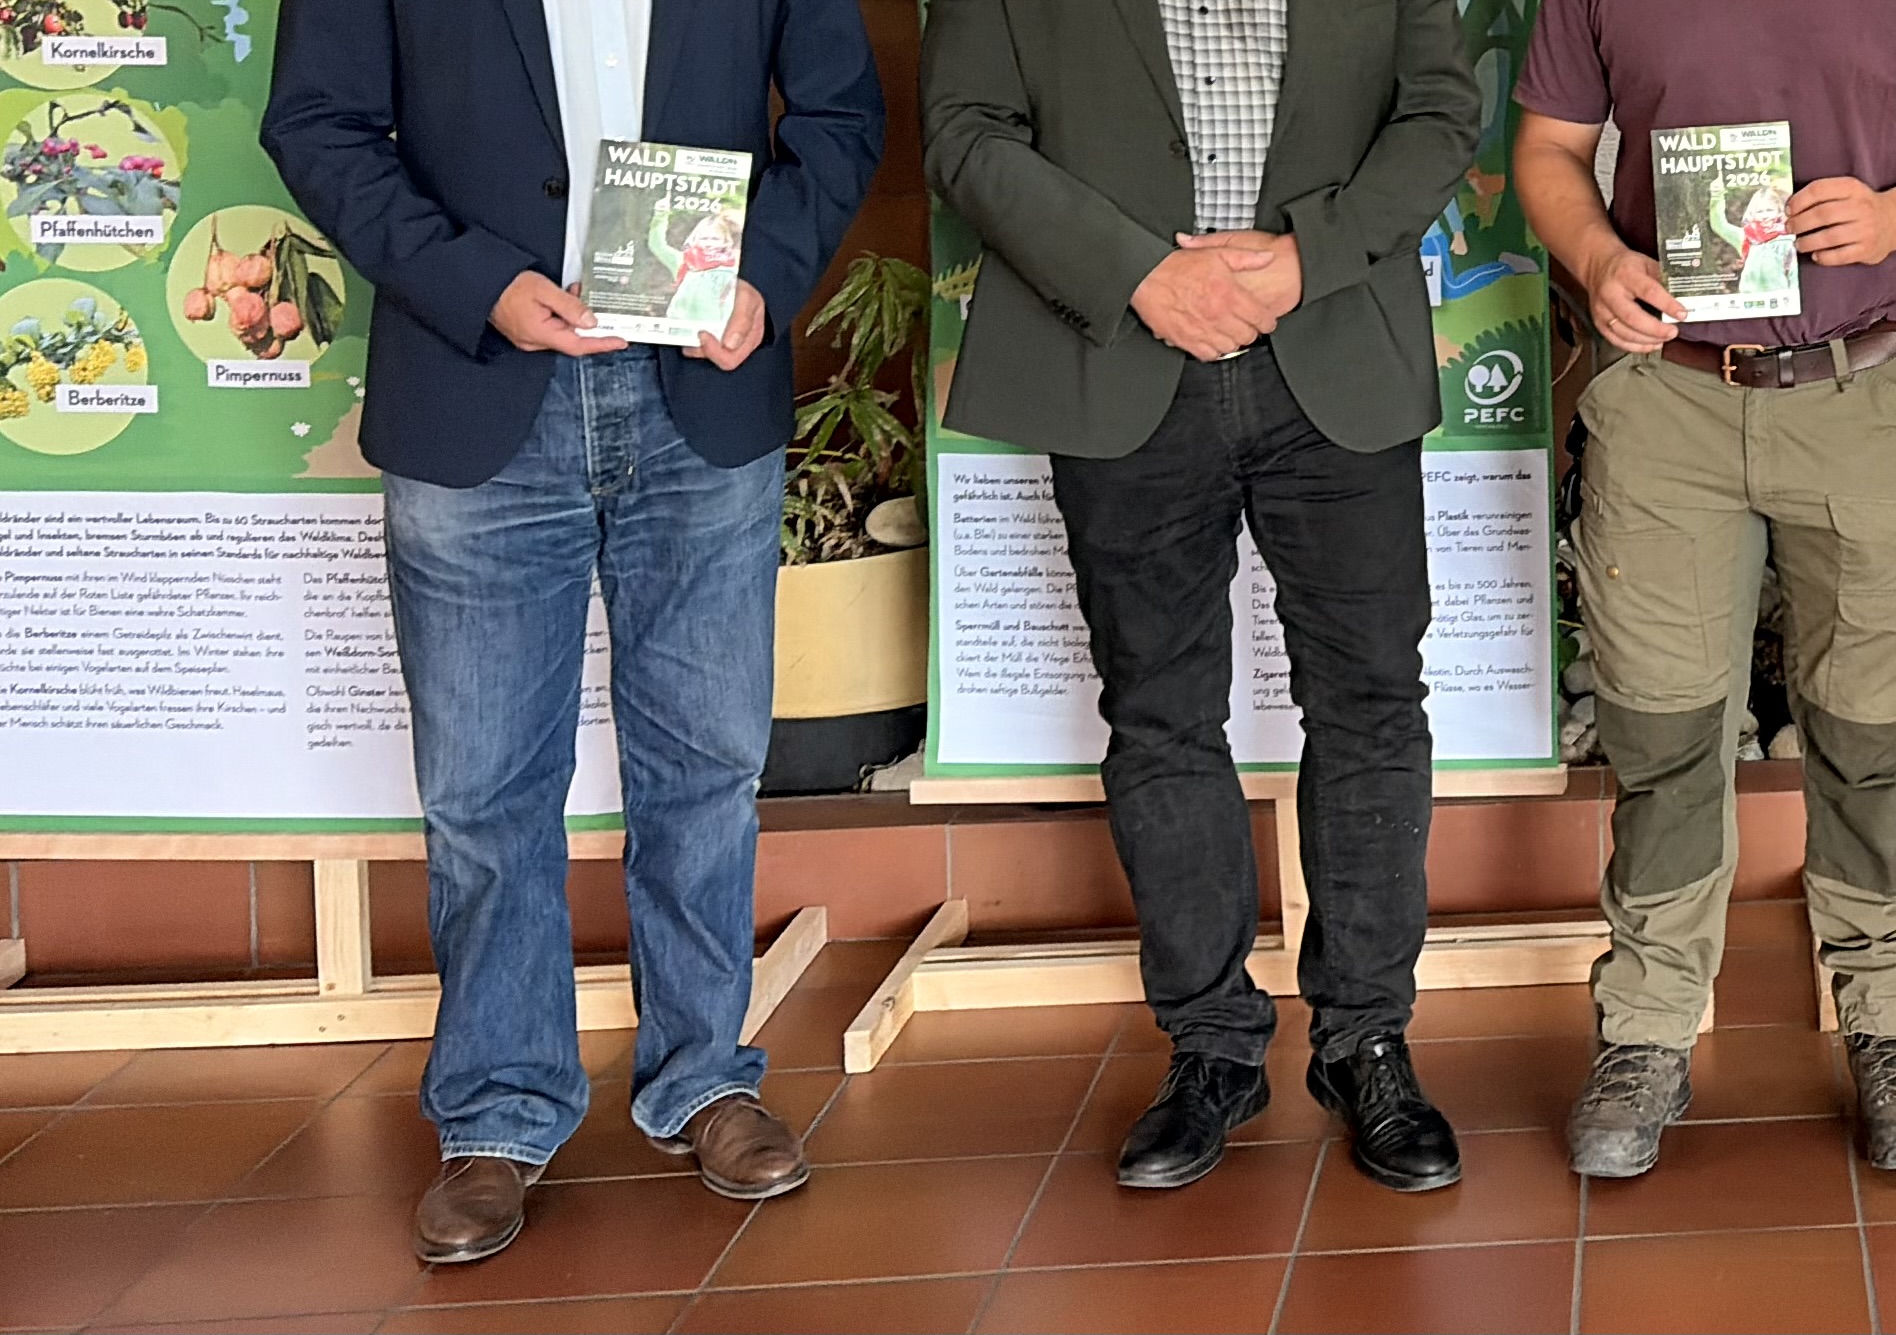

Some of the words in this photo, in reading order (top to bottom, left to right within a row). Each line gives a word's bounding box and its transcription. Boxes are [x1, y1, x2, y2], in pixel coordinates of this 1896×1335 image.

[51, 41, 155, 59] Kornelkirsche
[1659, 134, 1716, 151] WALD
[608, 146, 671, 168] WALD
[1661, 151, 1783, 174] HAUPTSTADT
[604, 168, 741, 196] HAUPTSTADT
[1726, 171, 1770, 187] 2026
[673, 196, 722, 213] 2026
[40, 220, 154, 238] Pfaffenhütchen
[215, 364, 303, 386] Pimpernuss
[68, 389, 146, 407] Berberitze
[1463, 407, 1525, 424] PEFC
